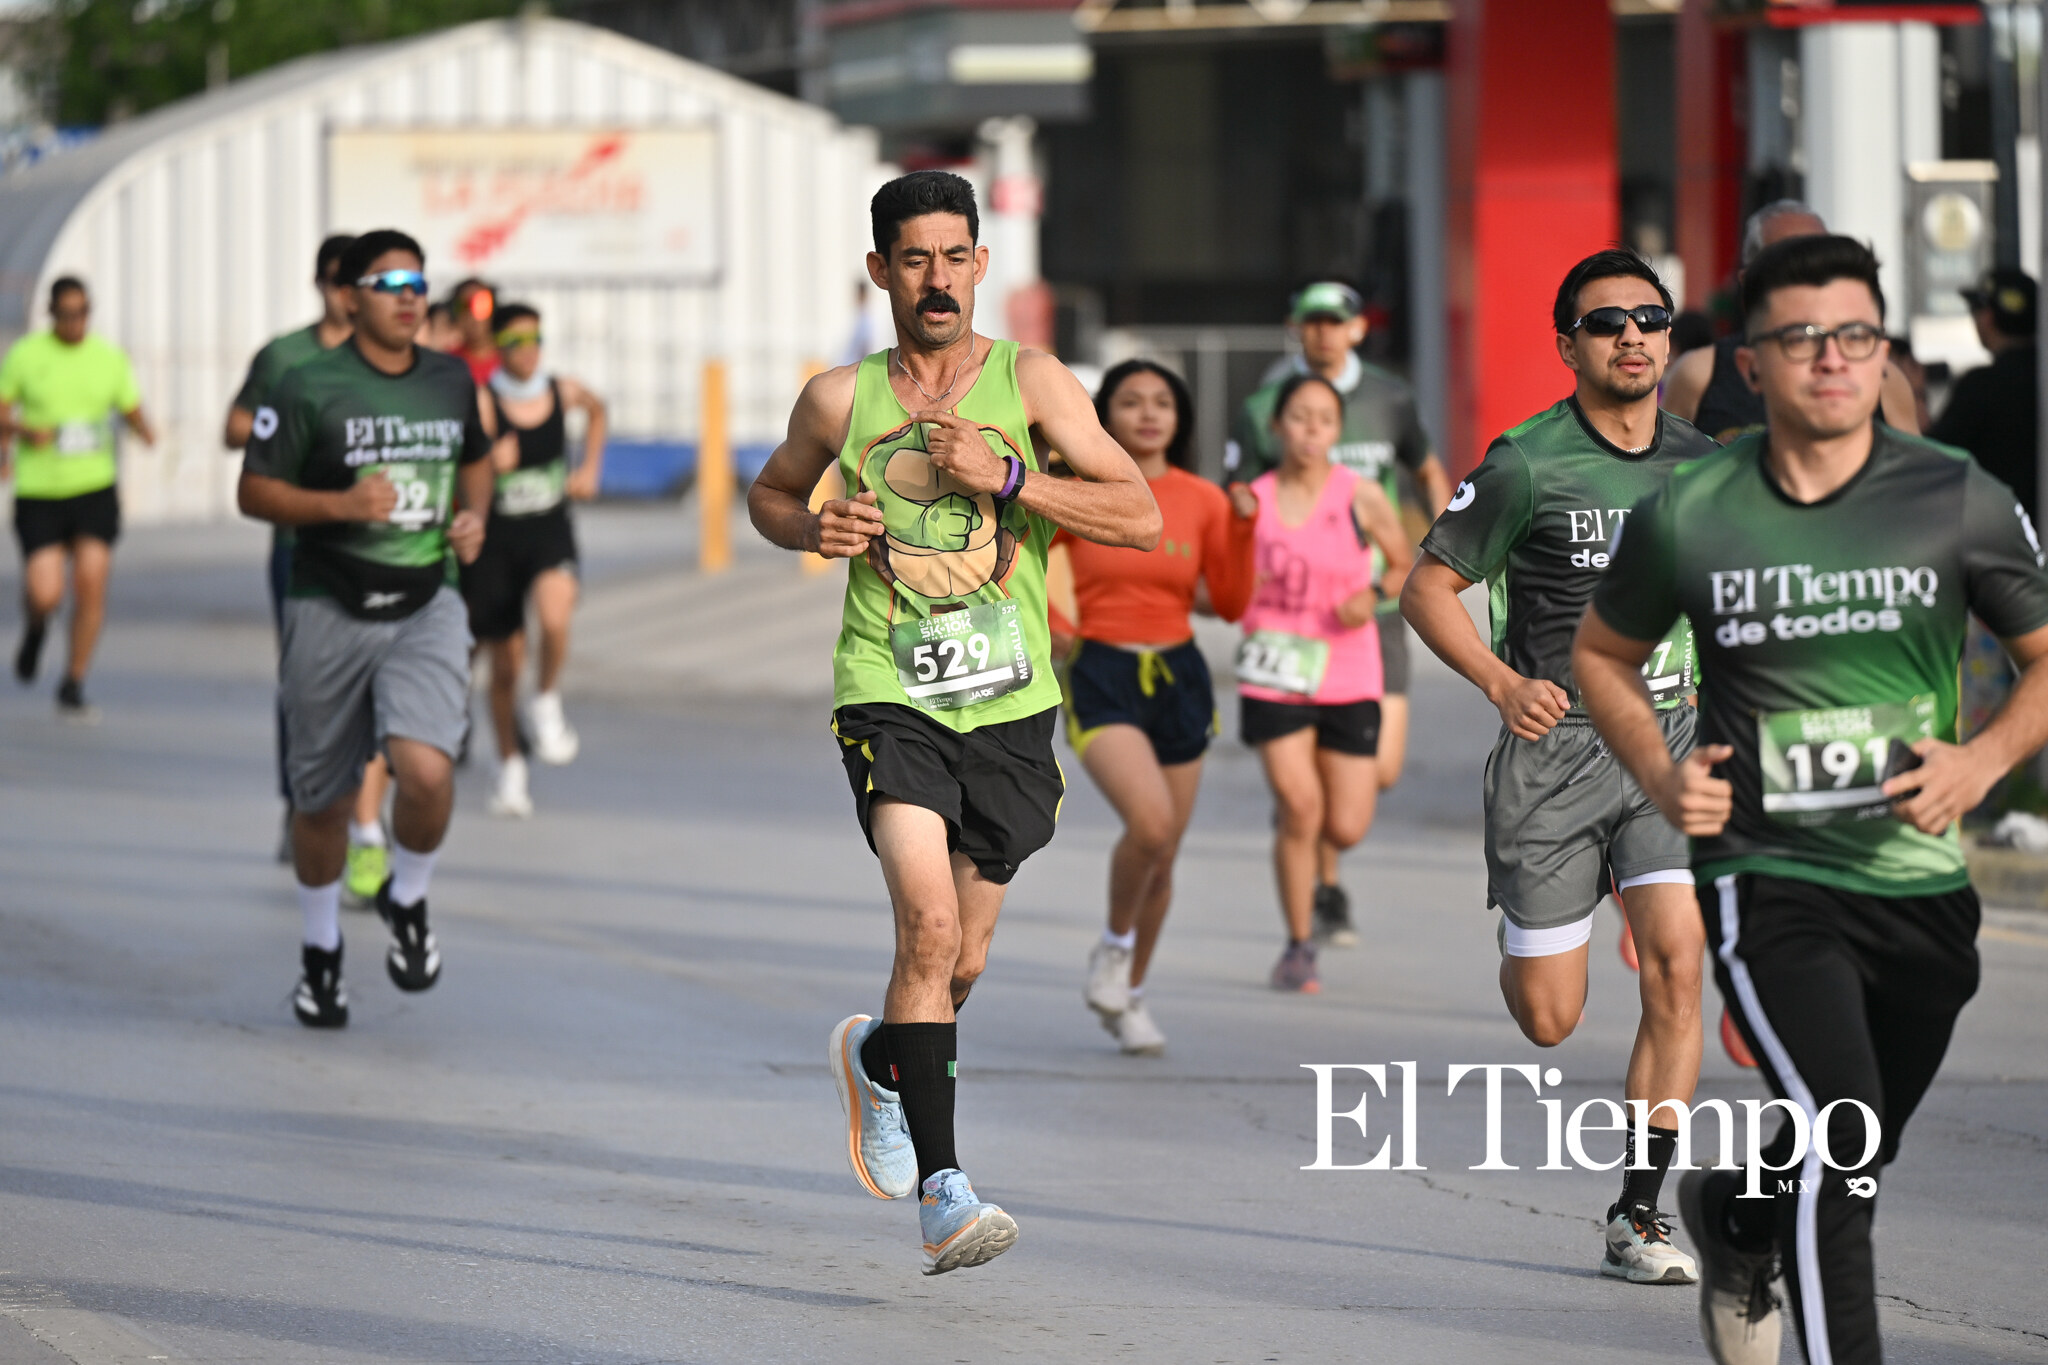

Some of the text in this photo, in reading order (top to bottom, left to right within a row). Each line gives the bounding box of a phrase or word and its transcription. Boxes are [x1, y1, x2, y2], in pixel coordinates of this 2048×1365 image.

[1566, 508, 1606, 543] El
[1570, 548, 1611, 568] de
[1001, 604, 1017, 615] 529
[1710, 563, 1939, 615] El Tiempo
[919, 611, 971, 627] CARRERA
[1715, 606, 1902, 648] de todos
[913, 633, 990, 682] 529
[1008, 619, 1028, 680] MEDALLA
[1683, 630, 1694, 687] MEDALLA
[1786, 736, 1888, 792] 191
